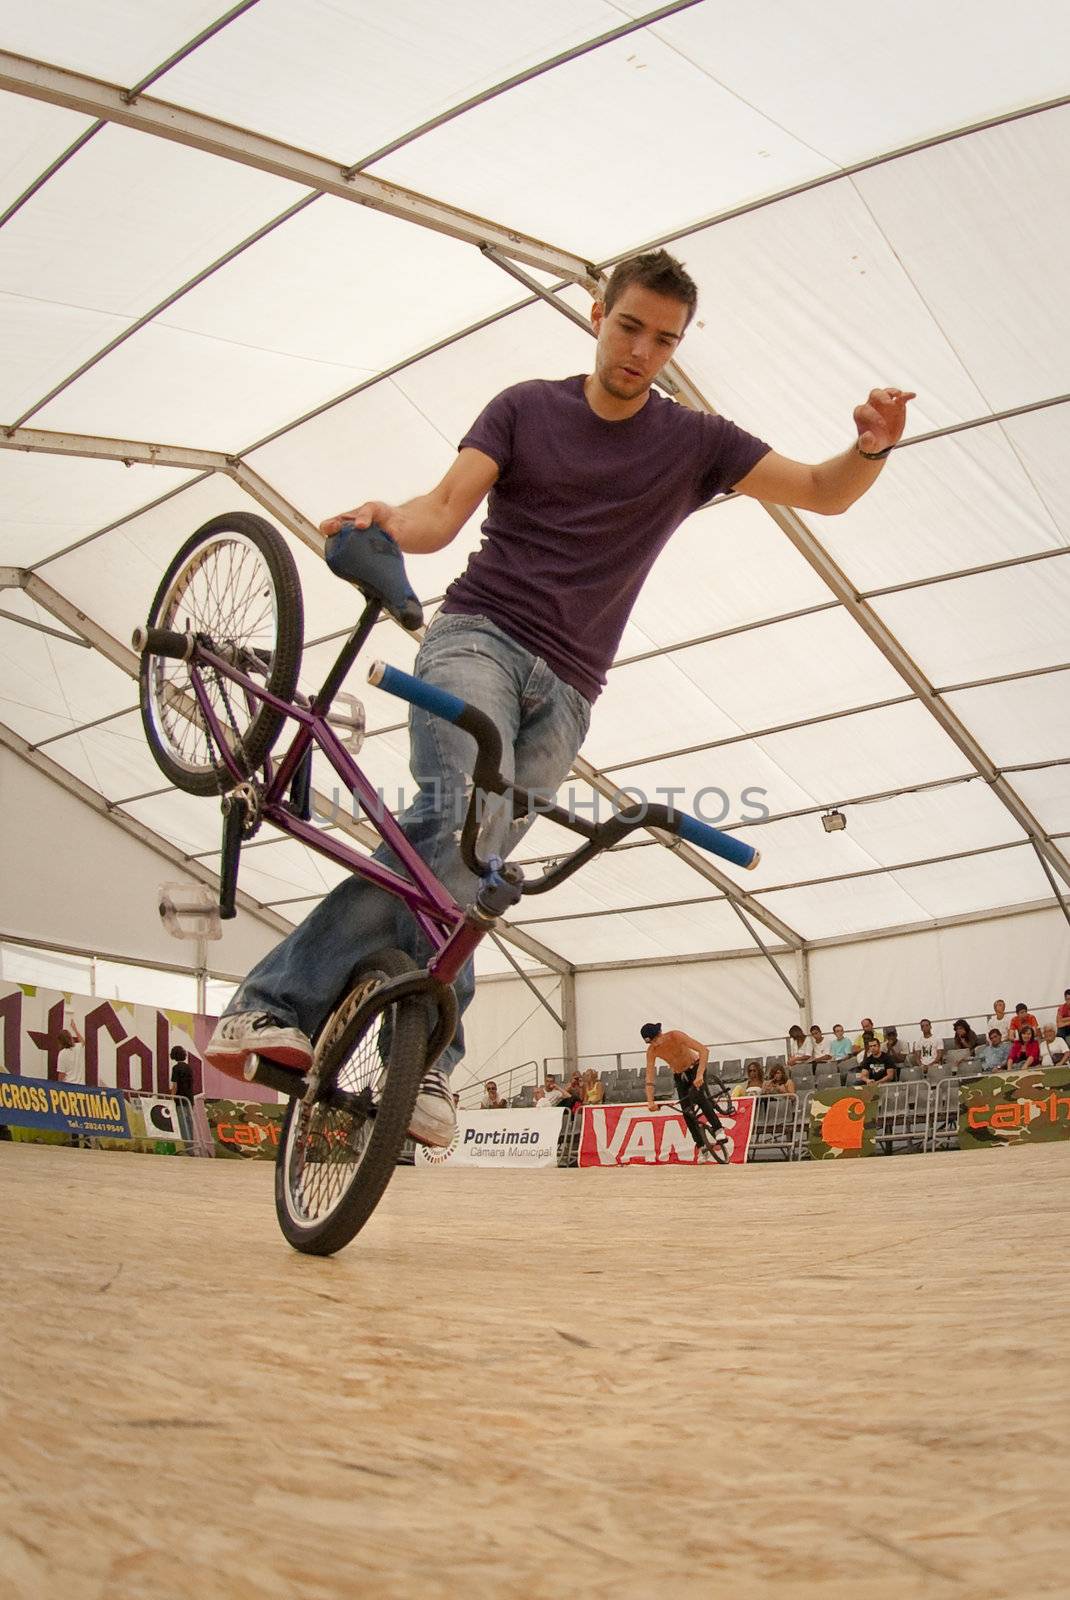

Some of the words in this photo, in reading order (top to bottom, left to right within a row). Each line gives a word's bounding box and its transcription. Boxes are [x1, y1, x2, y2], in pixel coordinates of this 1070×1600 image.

[0, 1082, 49, 1113] CROSS
[49, 1089, 121, 1121] PORTIMÃO
[464, 1128, 540, 1145] Portimão
[508, 1146, 553, 1159] Municipal
